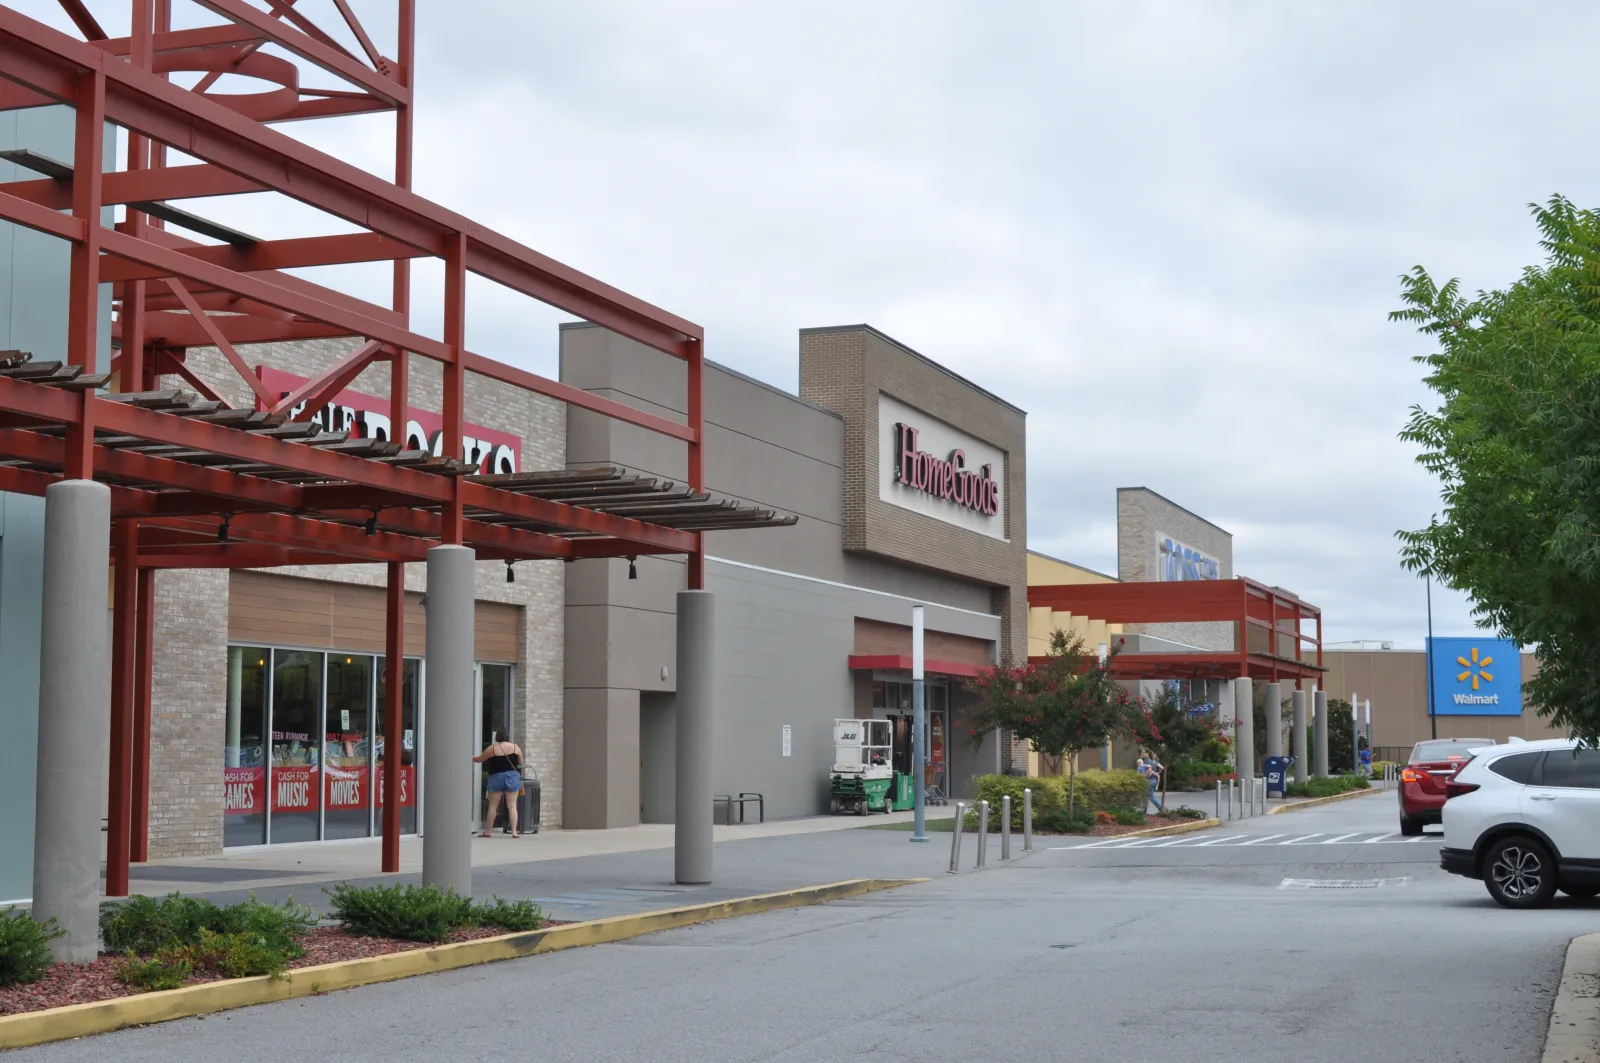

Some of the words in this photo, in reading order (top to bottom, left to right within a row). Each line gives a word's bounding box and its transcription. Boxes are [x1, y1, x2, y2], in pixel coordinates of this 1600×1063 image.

[895, 422, 999, 517] HomeGoods
[1453, 693, 1499, 705] Walmart
[240, 772, 254, 782] FOR
[278, 771, 295, 781] CASH
[296, 771, 309, 781] FOR
[277, 781, 309, 808] MUSIC
[330, 780, 360, 805] MOVIES
